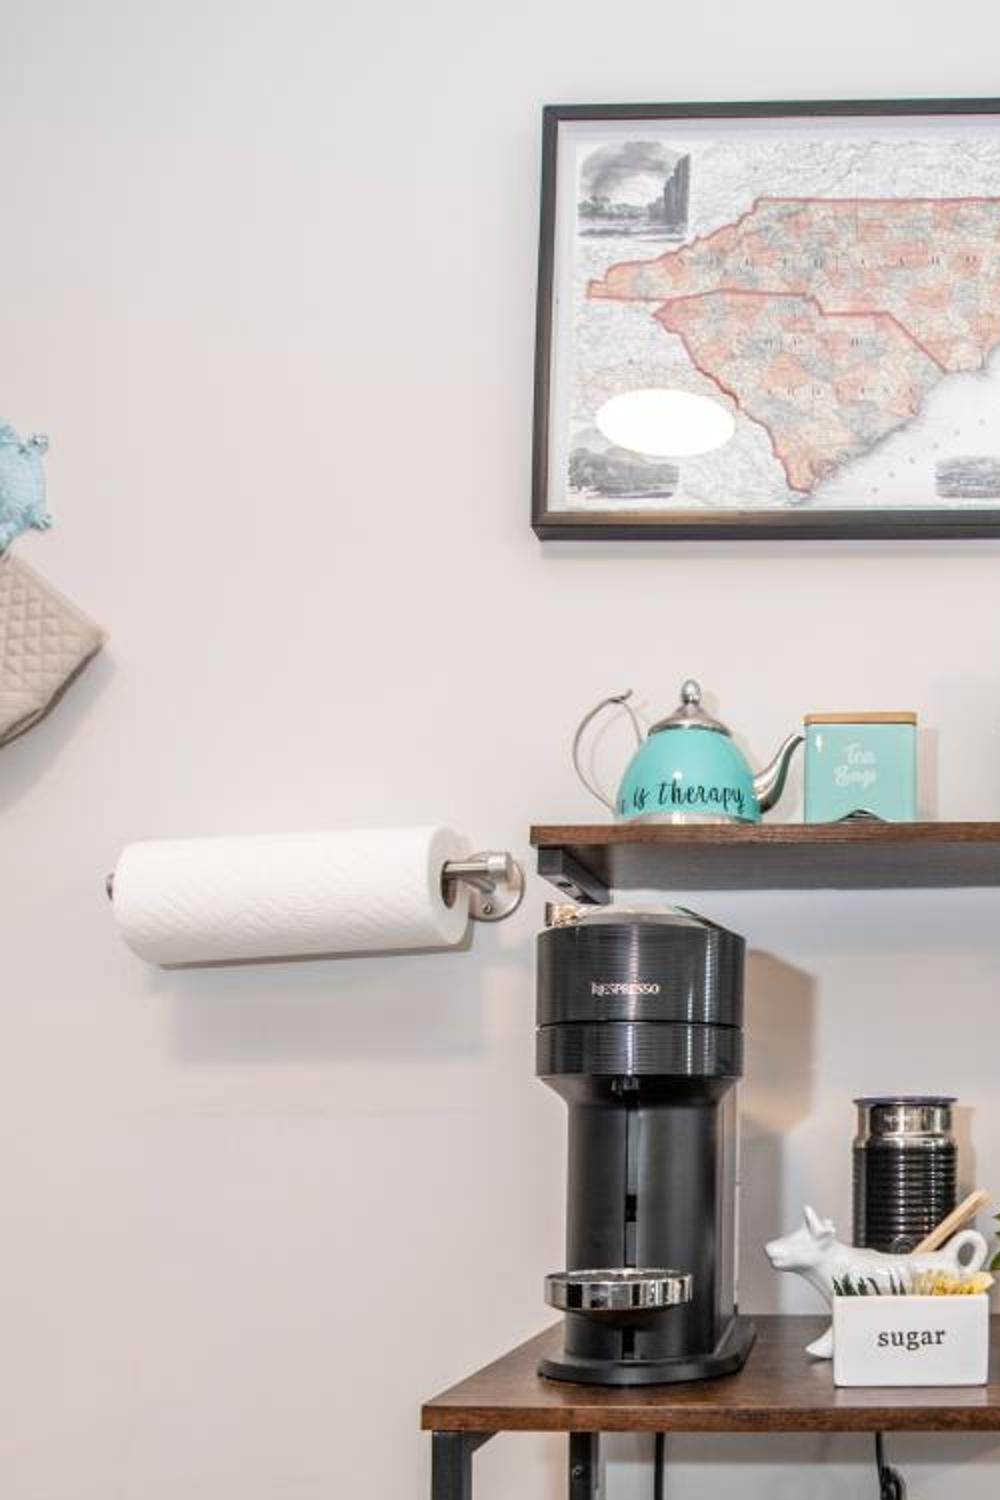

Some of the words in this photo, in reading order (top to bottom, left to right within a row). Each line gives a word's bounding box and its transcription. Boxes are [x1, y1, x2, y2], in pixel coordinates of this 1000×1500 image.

[633, 786, 650, 810] is
[656, 778, 746, 814] therapy
[877, 1330, 946, 1351] sugar
